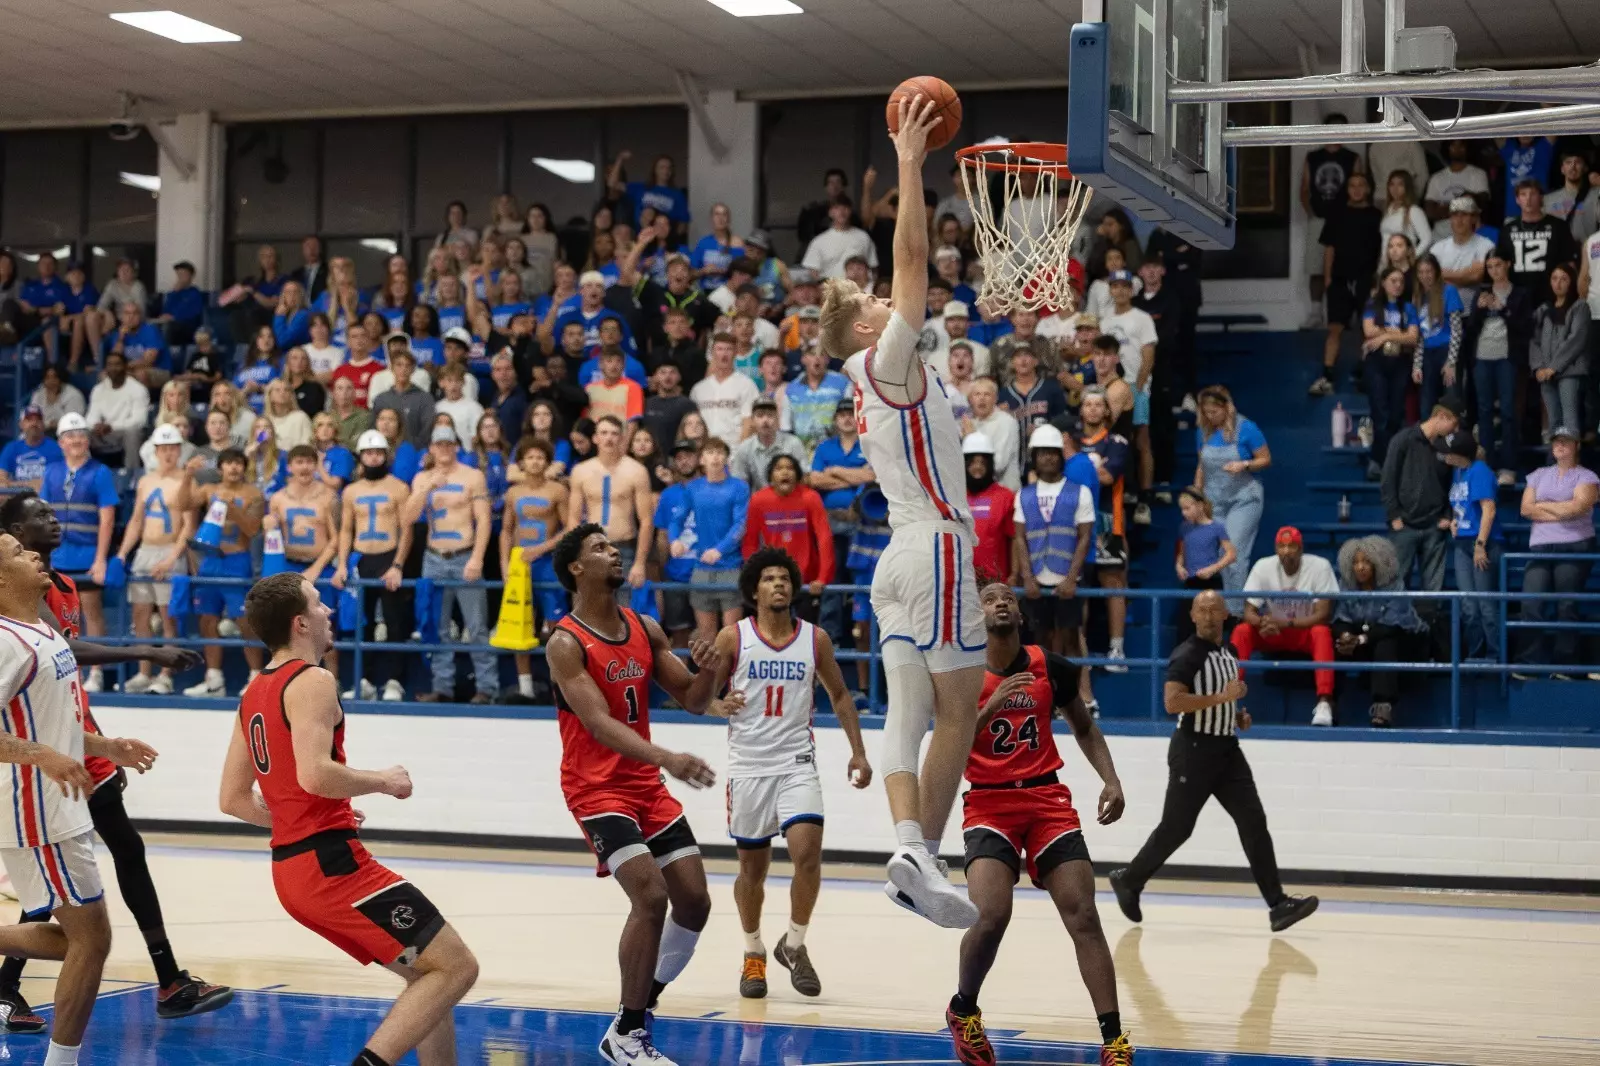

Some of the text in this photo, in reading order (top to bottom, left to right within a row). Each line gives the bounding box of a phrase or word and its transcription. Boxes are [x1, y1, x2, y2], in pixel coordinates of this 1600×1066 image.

[1513, 240, 1548, 272] 12
[144, 487, 172, 534] A
[286, 507, 316, 546] G
[355, 493, 389, 541] I
[426, 483, 464, 540] E
[515, 496, 550, 547] S
[606, 657, 645, 682] Colts
[747, 660, 806, 681] AGGIES
[624, 685, 639, 724] 1
[764, 685, 784, 717] 11
[1003, 688, 1036, 711] olts
[249, 713, 271, 775] 0
[989, 715, 1040, 755] 24
